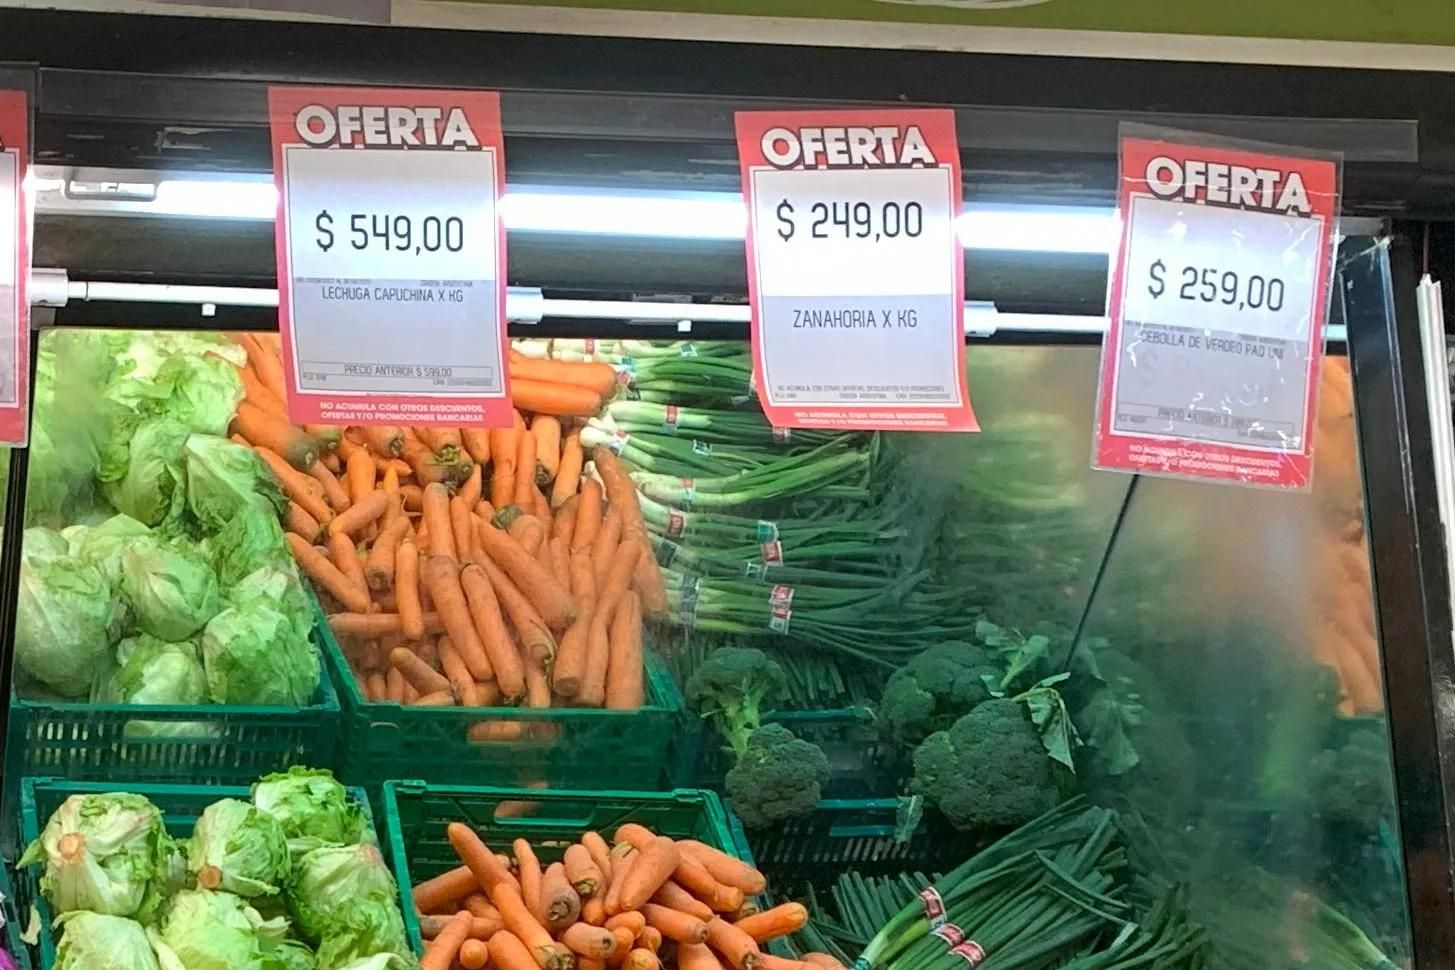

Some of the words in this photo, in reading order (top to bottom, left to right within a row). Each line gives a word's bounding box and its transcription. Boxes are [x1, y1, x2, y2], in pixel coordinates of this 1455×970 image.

[295, 104, 479, 147] OFERTA
[761, 127, 936, 167] OFERTA
[1146, 156, 1311, 213] OFERTA
[315, 210, 334, 252] $
[350, 214, 464, 256] 549,00
[776, 198, 795, 242] $
[811, 201, 922, 242] 249,00
[322, 286, 370, 301] LECHUGA
[374, 287, 434, 302] CAPUCHINA
[439, 290, 445, 302] X
[449, 289, 464, 303] KG
[1148, 259, 1165, 299] $
[1180, 266, 1284, 312] 259,00
[793, 310, 876, 329] ZANAHORIA
[883, 310, 892, 328] X
[898, 309, 917, 328] KG
[1141, 330, 1185, 348] CEBOLLA
[1189, 335, 1201, 349] DE
[1206, 338, 1242, 354] VERDEO
[344, 365, 372, 375] PRECIO
